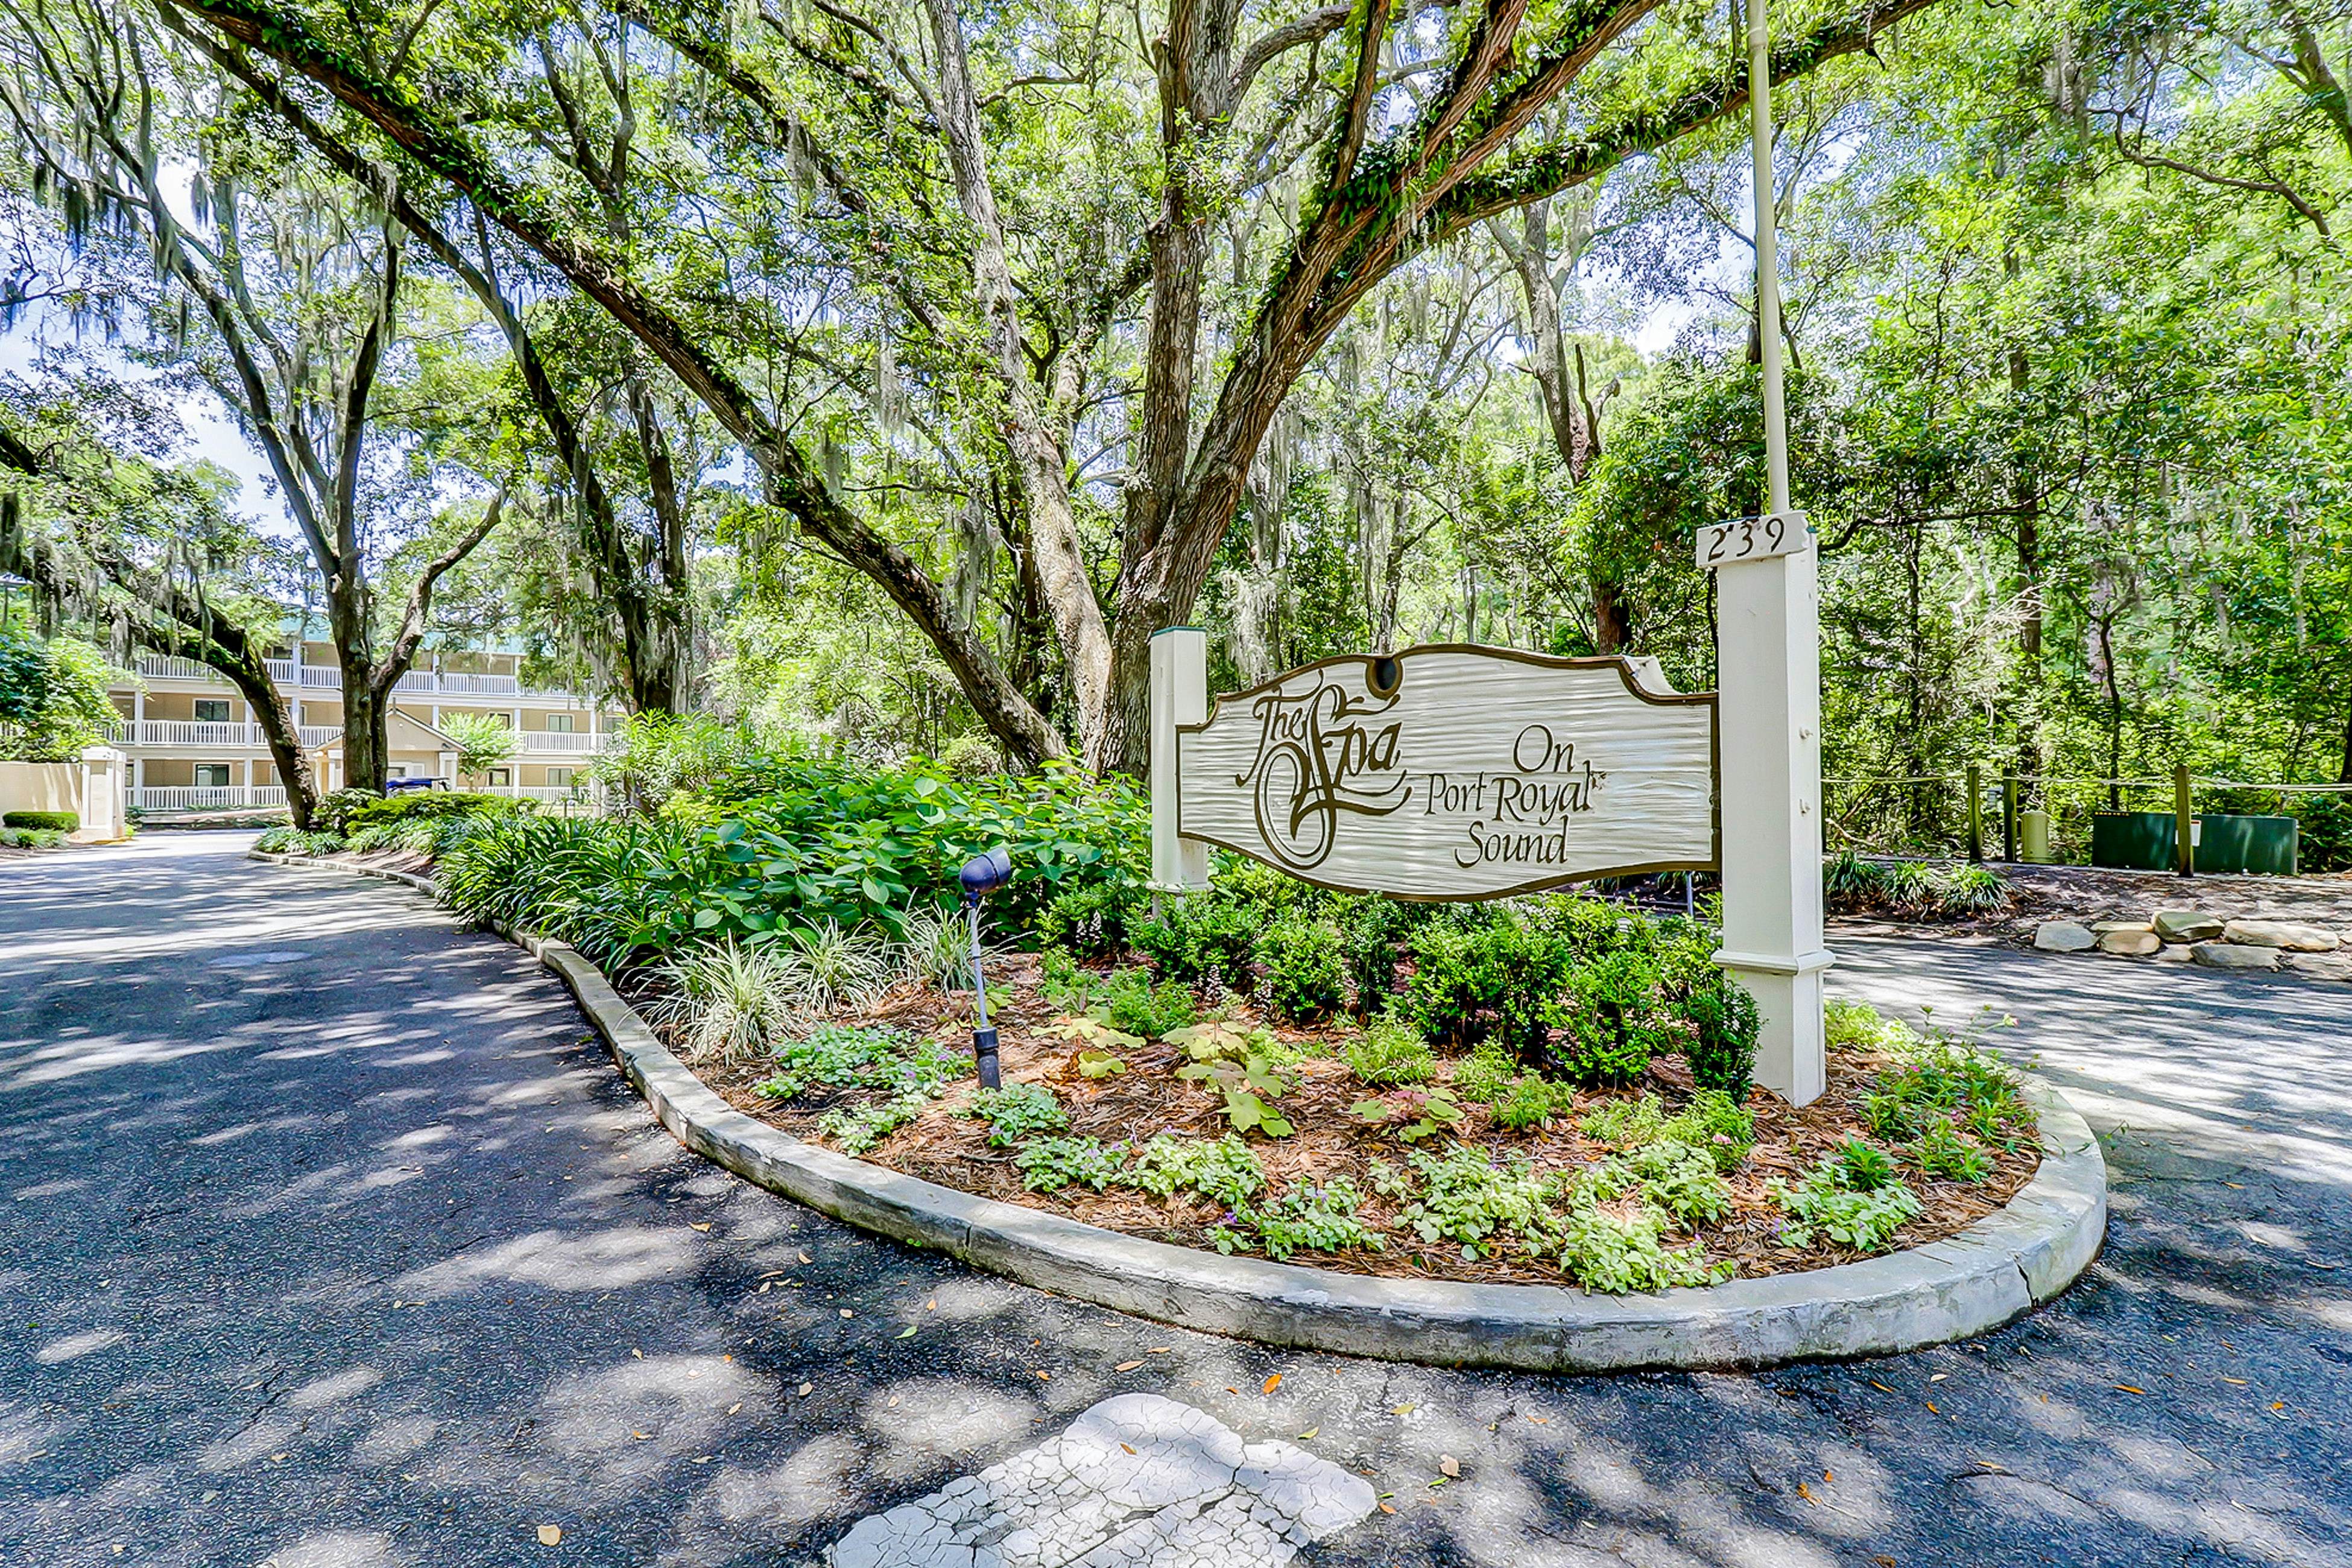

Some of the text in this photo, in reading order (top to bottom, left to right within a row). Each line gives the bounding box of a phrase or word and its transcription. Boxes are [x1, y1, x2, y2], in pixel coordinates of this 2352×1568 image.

[1707, 517, 1785, 562] 239
[1236, 668, 1323, 787] The
[1513, 724, 1574, 773] On
[1254, 684, 1412, 870] Spa
[1424, 760, 1593, 826] Port Royal
[1455, 815, 1568, 868] Sound
